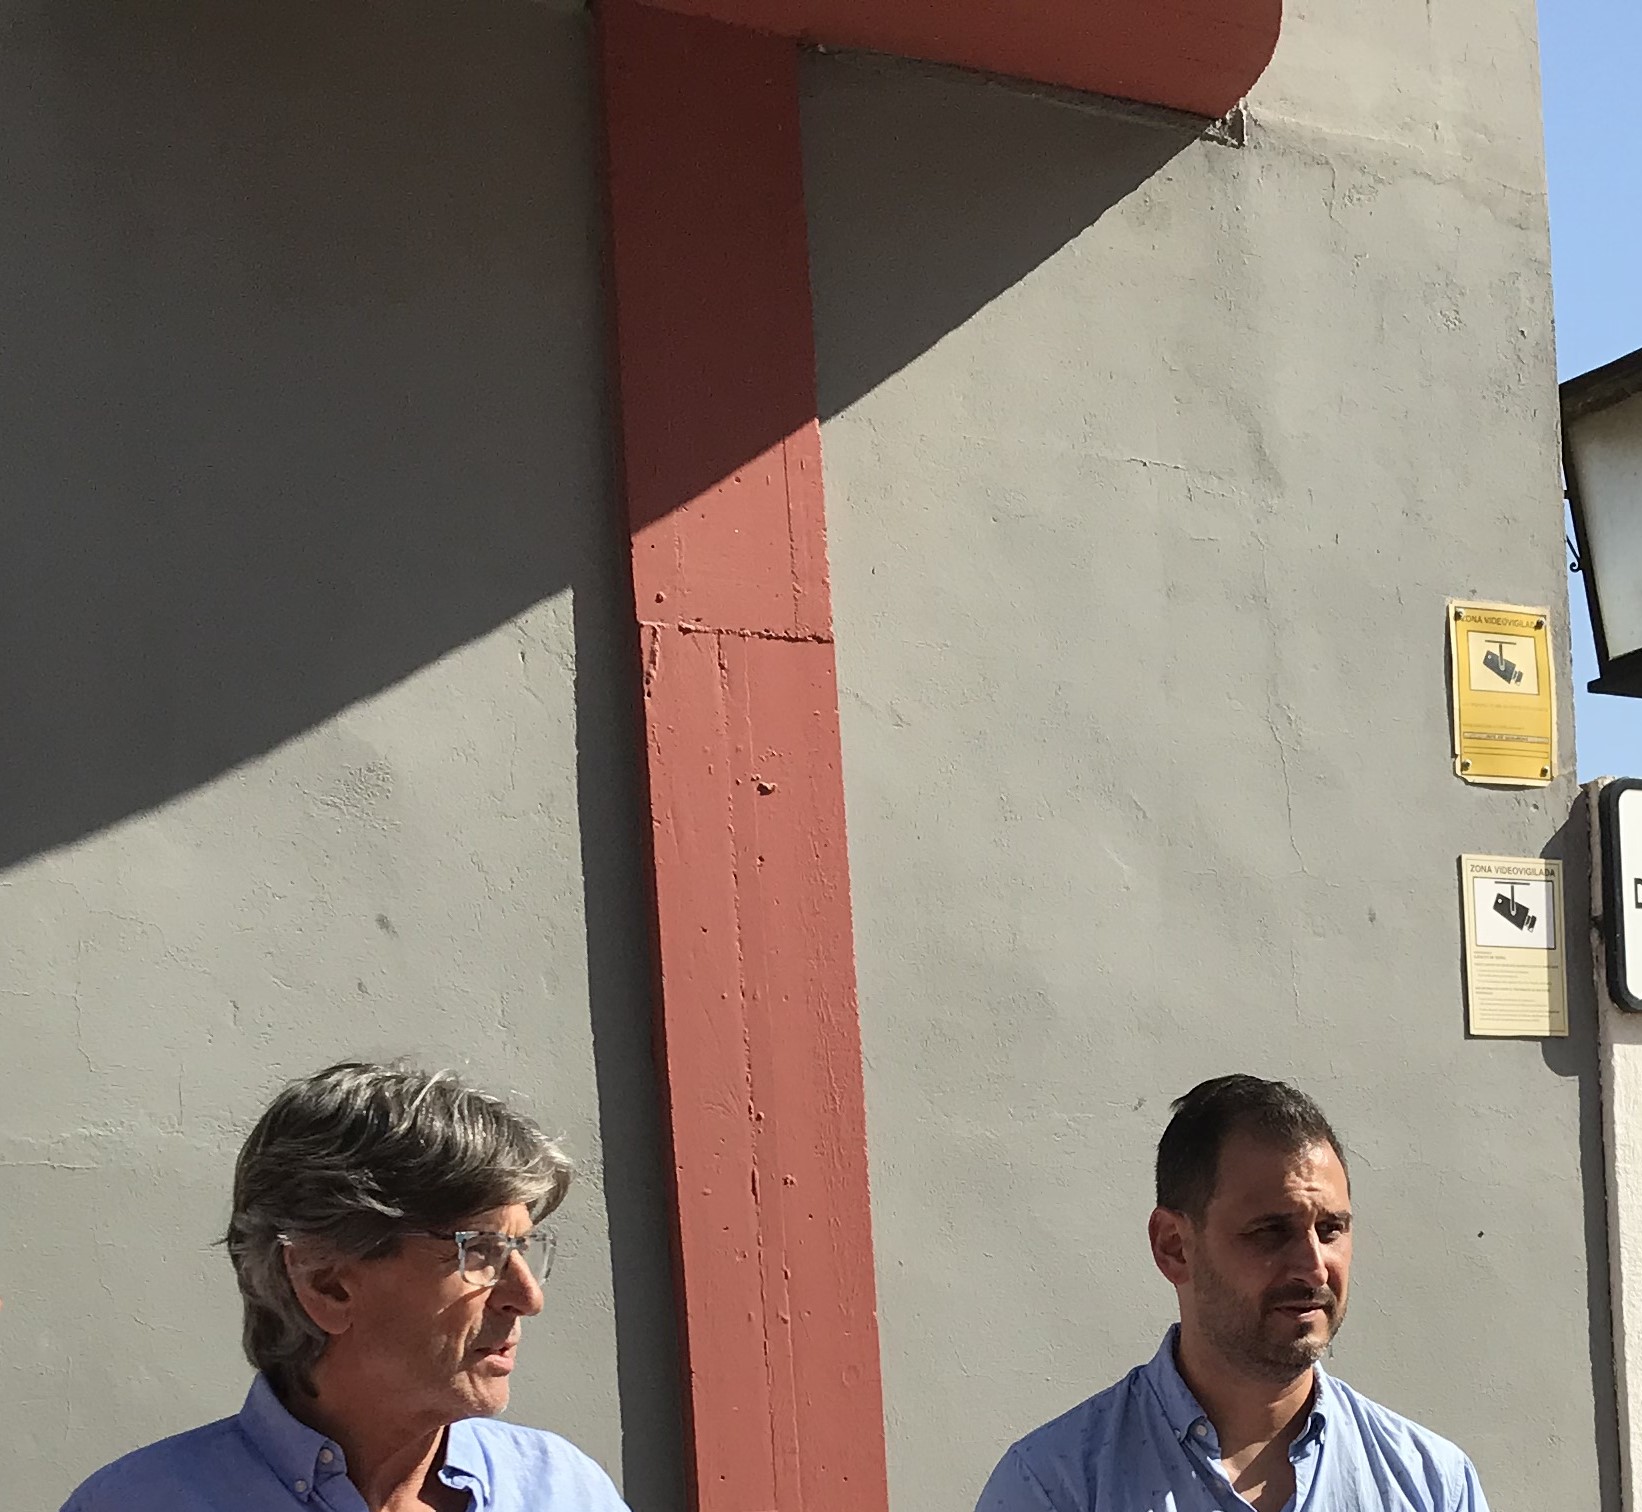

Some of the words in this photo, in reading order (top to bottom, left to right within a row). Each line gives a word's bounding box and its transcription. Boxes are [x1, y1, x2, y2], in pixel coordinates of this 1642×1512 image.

[1484, 617, 1536, 629] VIDEOVIGILAD
[1470, 864, 1492, 873] ZONA
[1494, 866, 1556, 877] VIDEOVIGILADA
